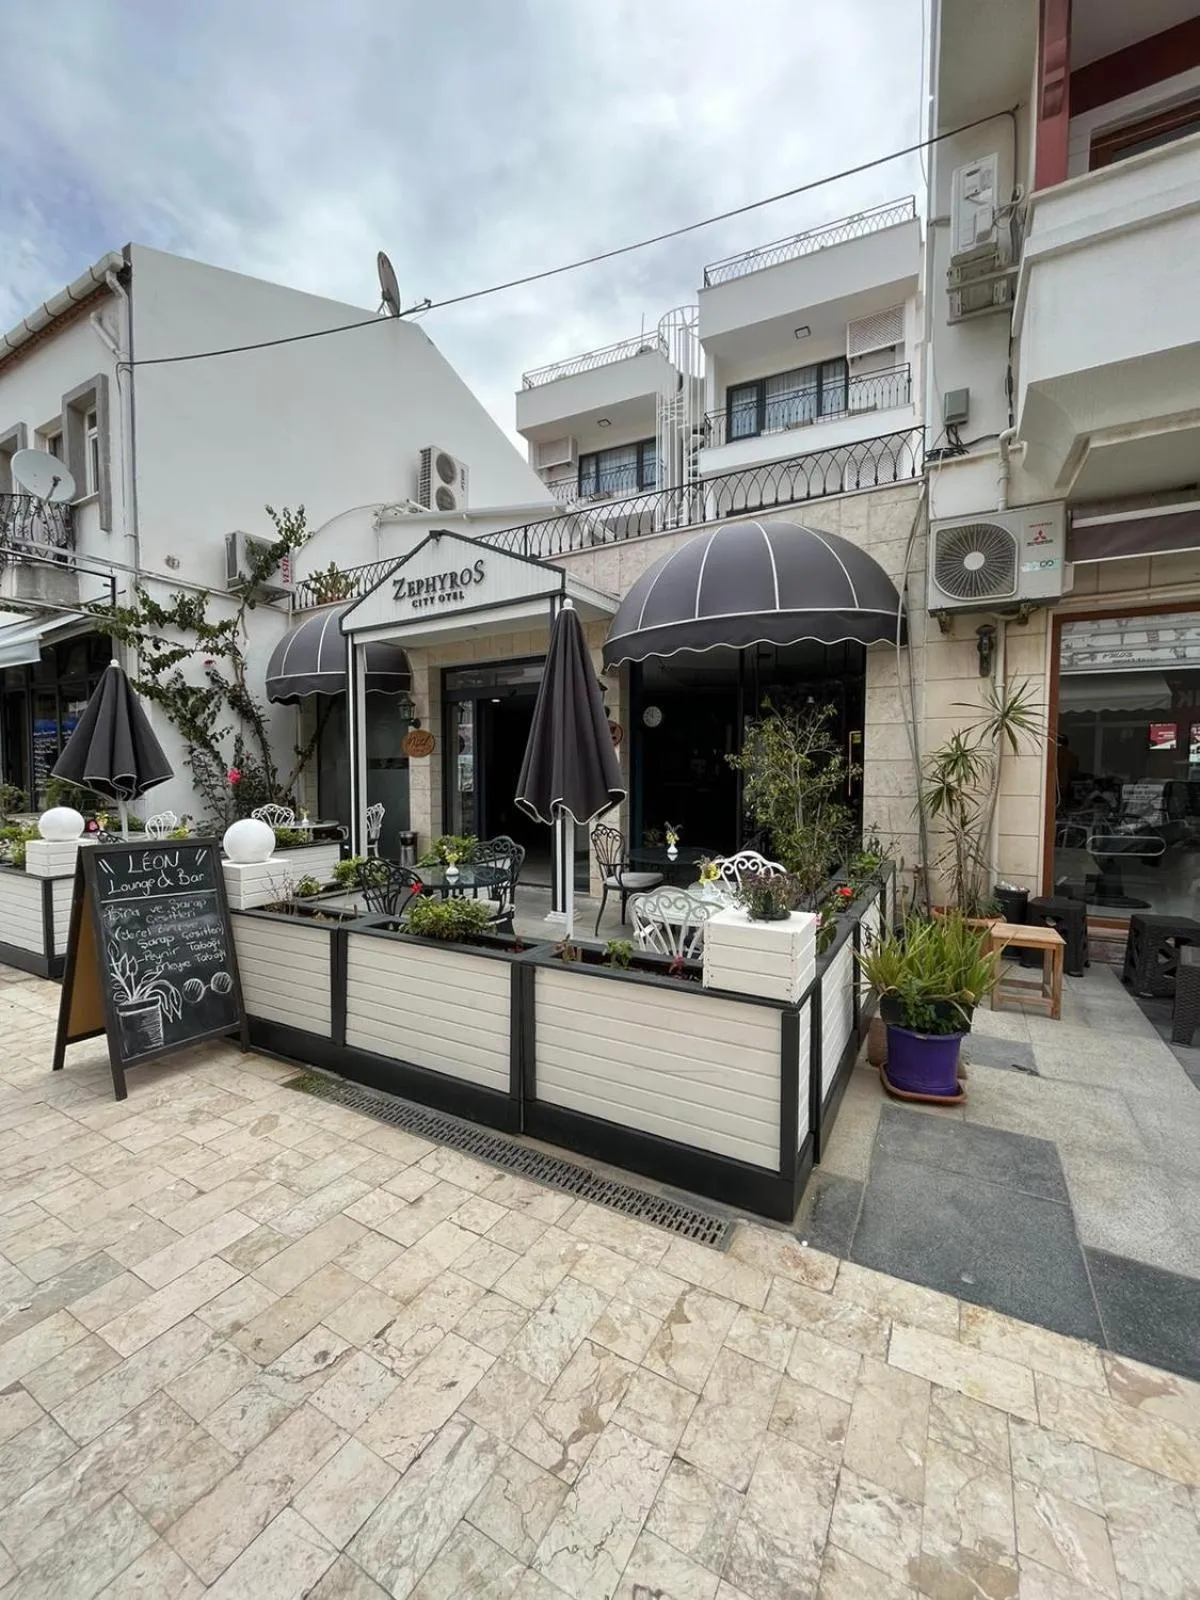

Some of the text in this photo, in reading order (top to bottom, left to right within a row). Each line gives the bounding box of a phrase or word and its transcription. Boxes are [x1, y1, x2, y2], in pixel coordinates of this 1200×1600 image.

[393, 559, 485, 600] ZEPHYROS
[412, 591, 465, 608] CITY OTEL
[128, 851, 180, 873] LÉON
[108, 878, 155, 897] Lounge
[177, 868, 205, 885] Bar
